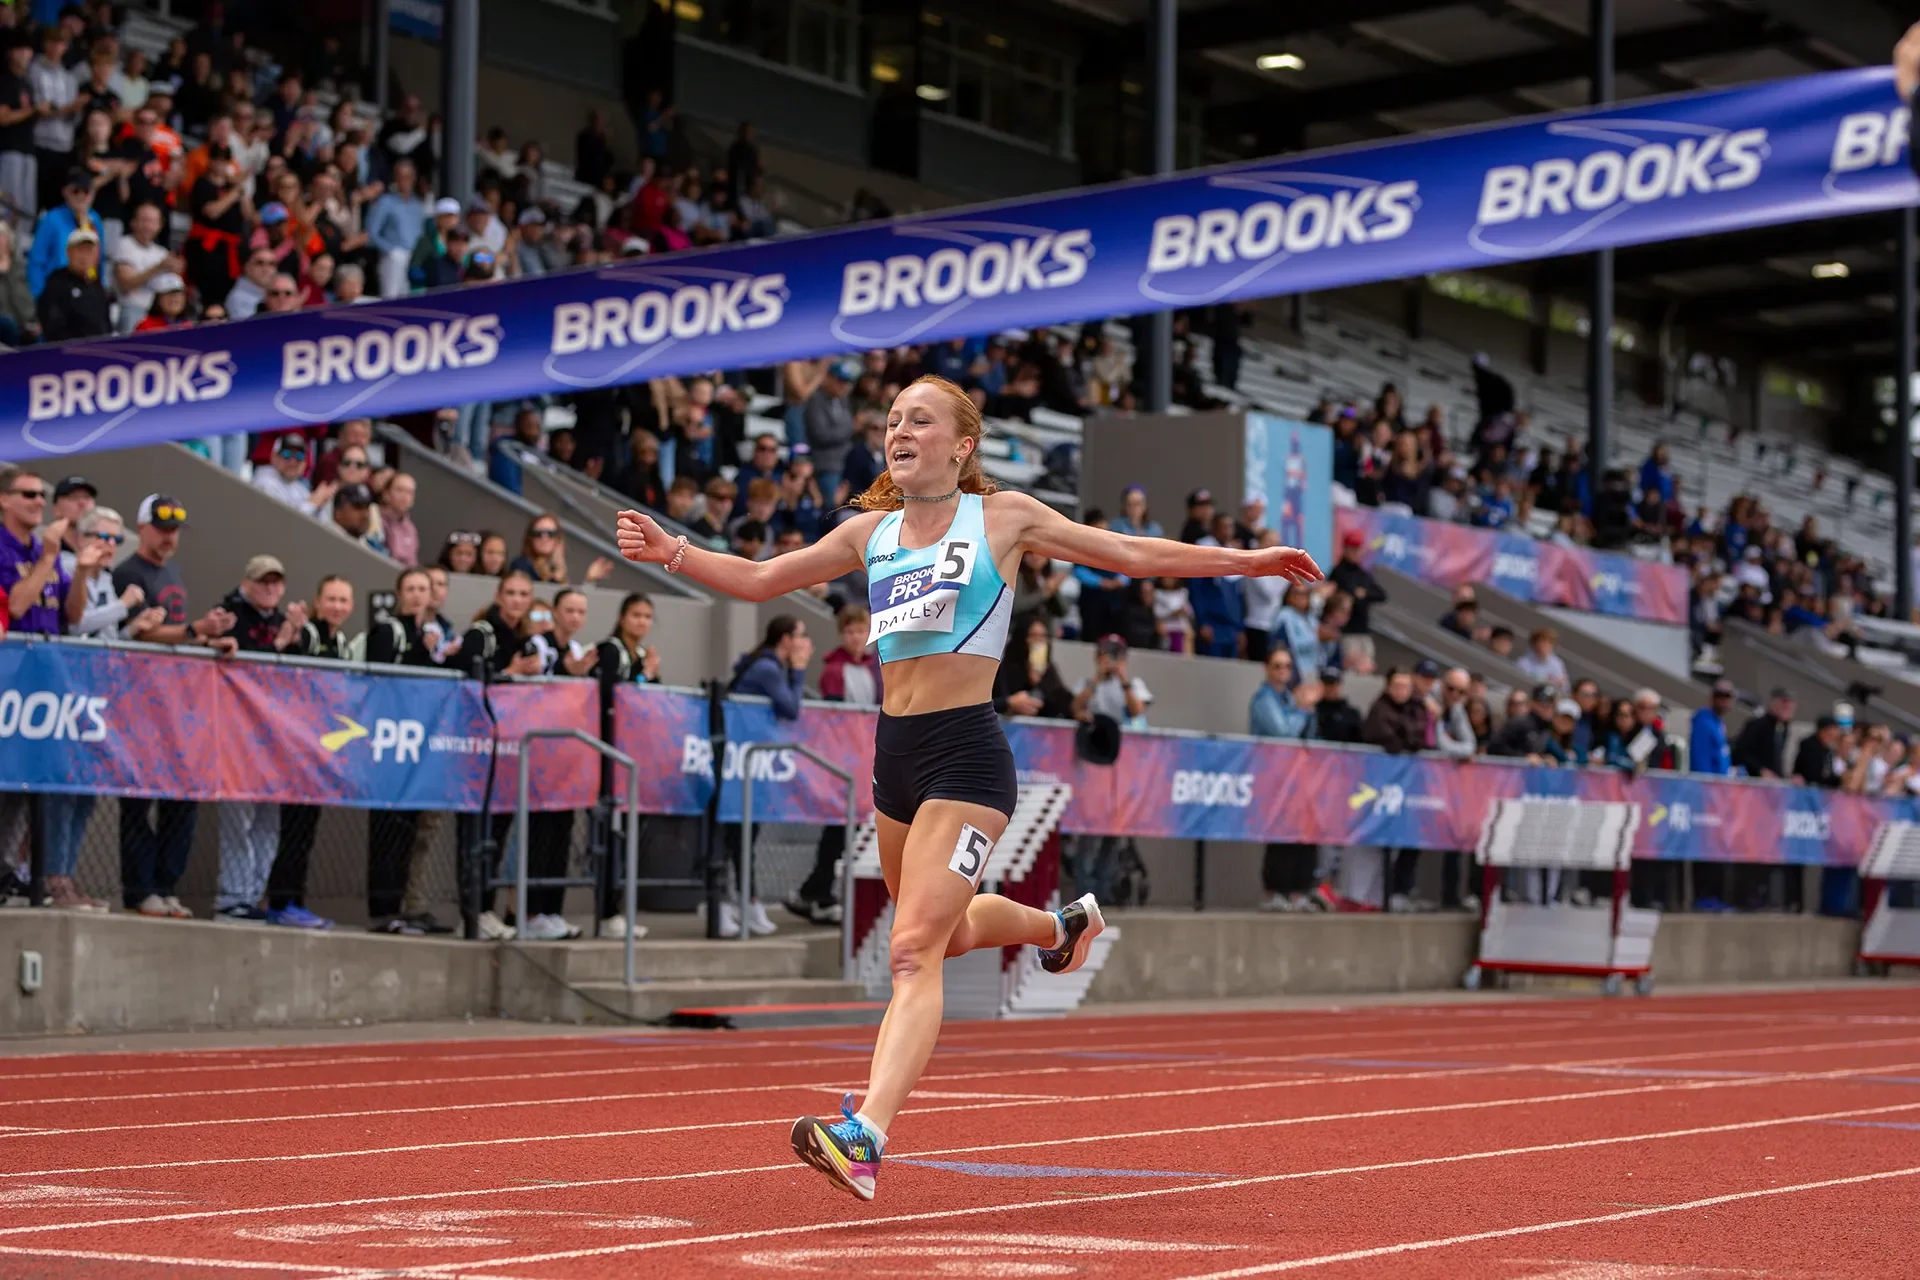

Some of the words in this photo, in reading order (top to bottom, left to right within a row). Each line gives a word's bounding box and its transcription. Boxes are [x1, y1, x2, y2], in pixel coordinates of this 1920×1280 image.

[28, 350, 233, 421] BROOKS
[281, 313, 499, 390] BROOKS
[551, 273, 785, 355] BROOKS
[839, 228, 1092, 317] BROOKS
[1147, 180, 1419, 273] BROOKS
[1477, 127, 1768, 226] BROOKS
[894, 566, 936, 586] BROOK
[939, 541, 970, 580] 5
[886, 580, 922, 605] PR
[878, 602, 947, 634] DAILEY
[0, 688, 108, 742] OOKS
[371, 717, 425, 764] PR
[958, 830, 988, 877] 5
[847, 1145, 871, 1161] HOKA
